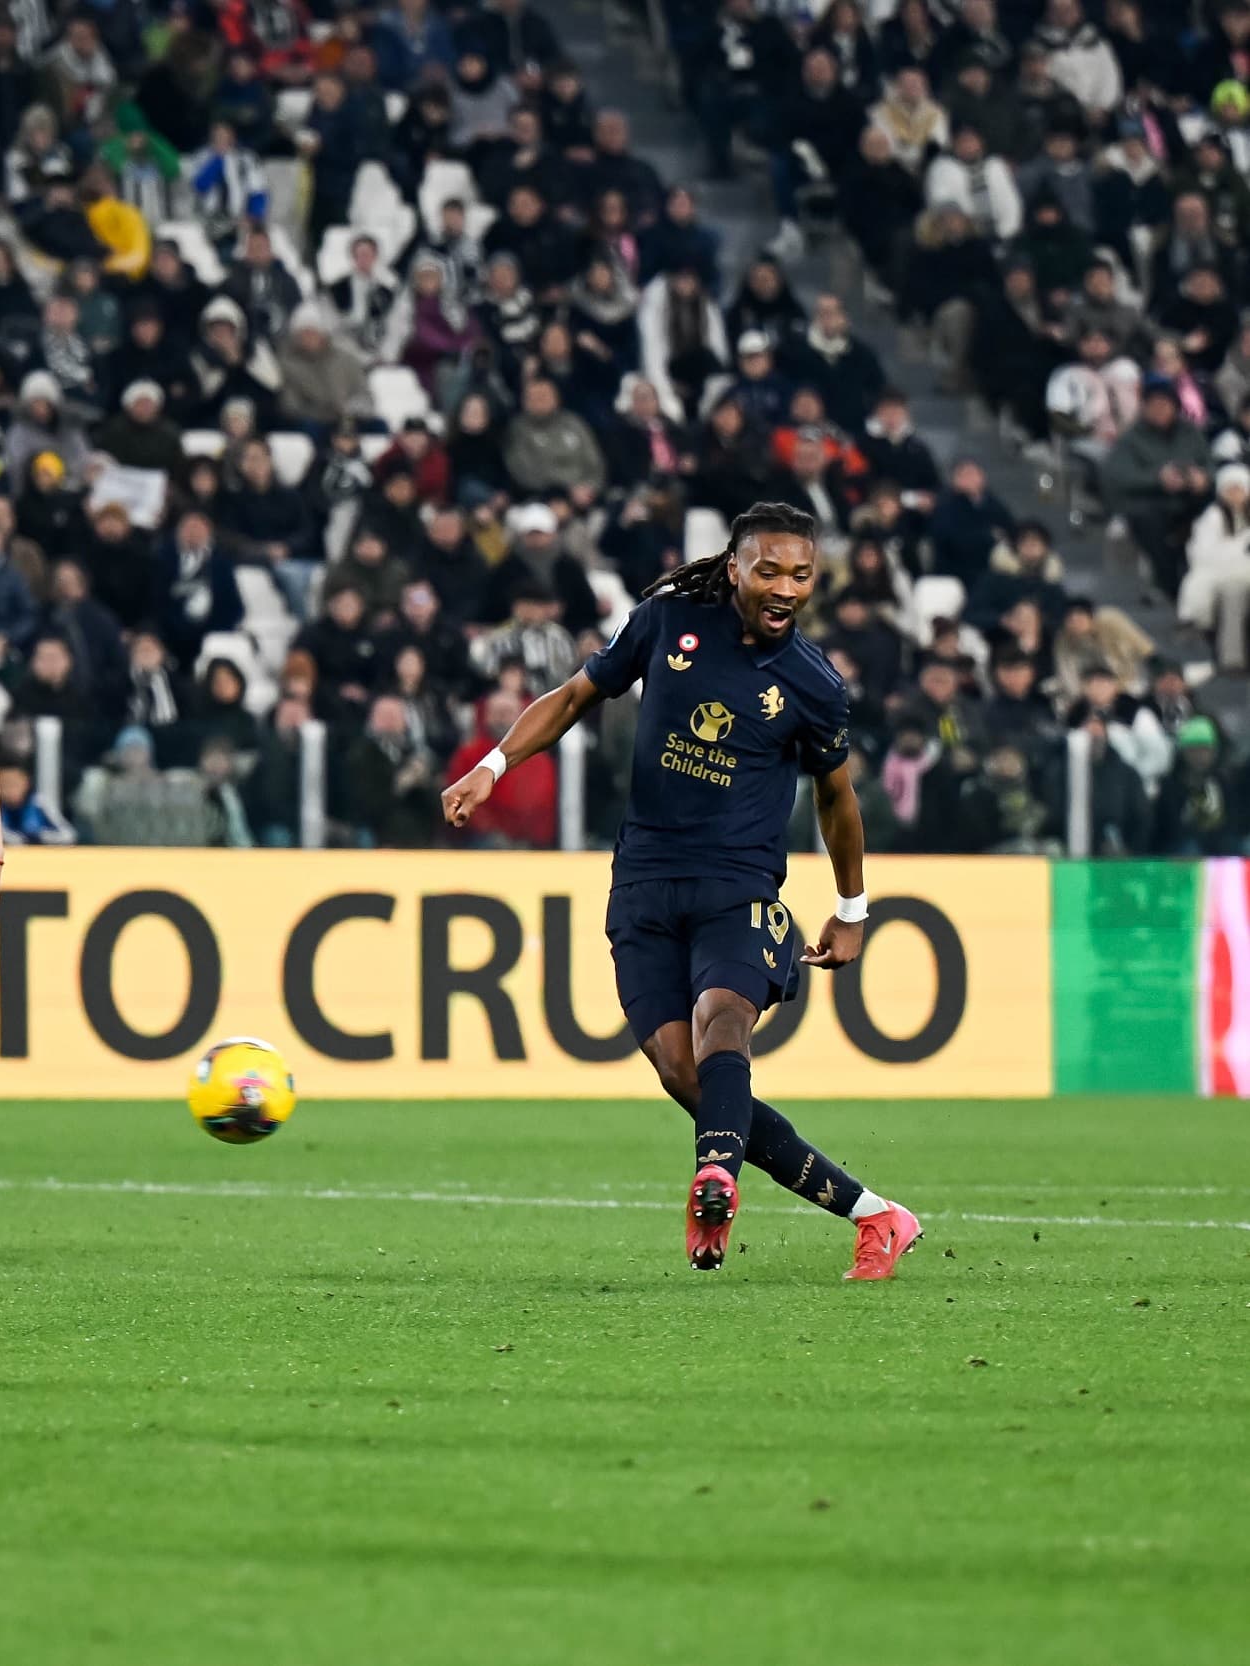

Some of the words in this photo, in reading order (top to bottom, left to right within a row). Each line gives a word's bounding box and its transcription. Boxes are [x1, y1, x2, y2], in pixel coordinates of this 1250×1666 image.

[660, 751, 733, 787] Children
[665, 732, 705, 758] Save
[708, 748, 738, 769] the
[751, 901, 789, 945] 19
